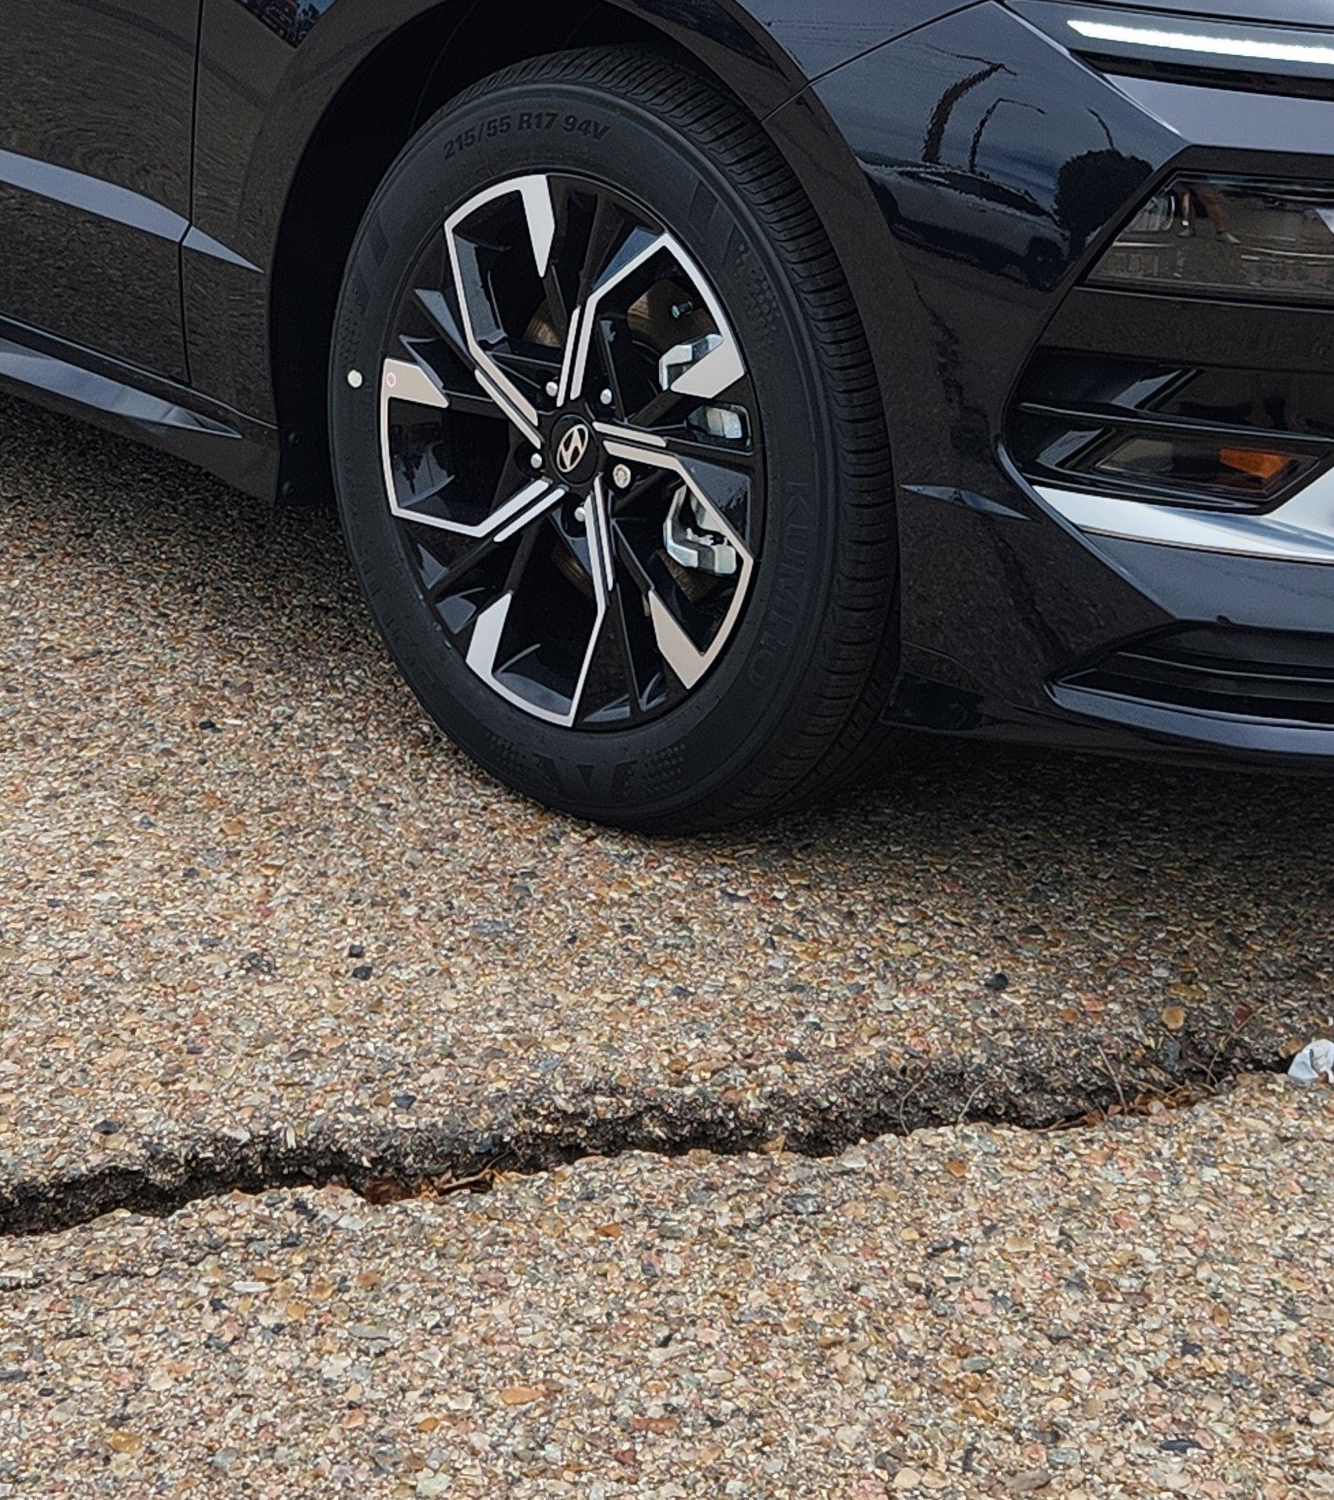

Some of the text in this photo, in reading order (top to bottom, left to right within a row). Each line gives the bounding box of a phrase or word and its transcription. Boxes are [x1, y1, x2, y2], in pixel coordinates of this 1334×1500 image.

[443, 111, 611, 160] 215/55 R17 94V
